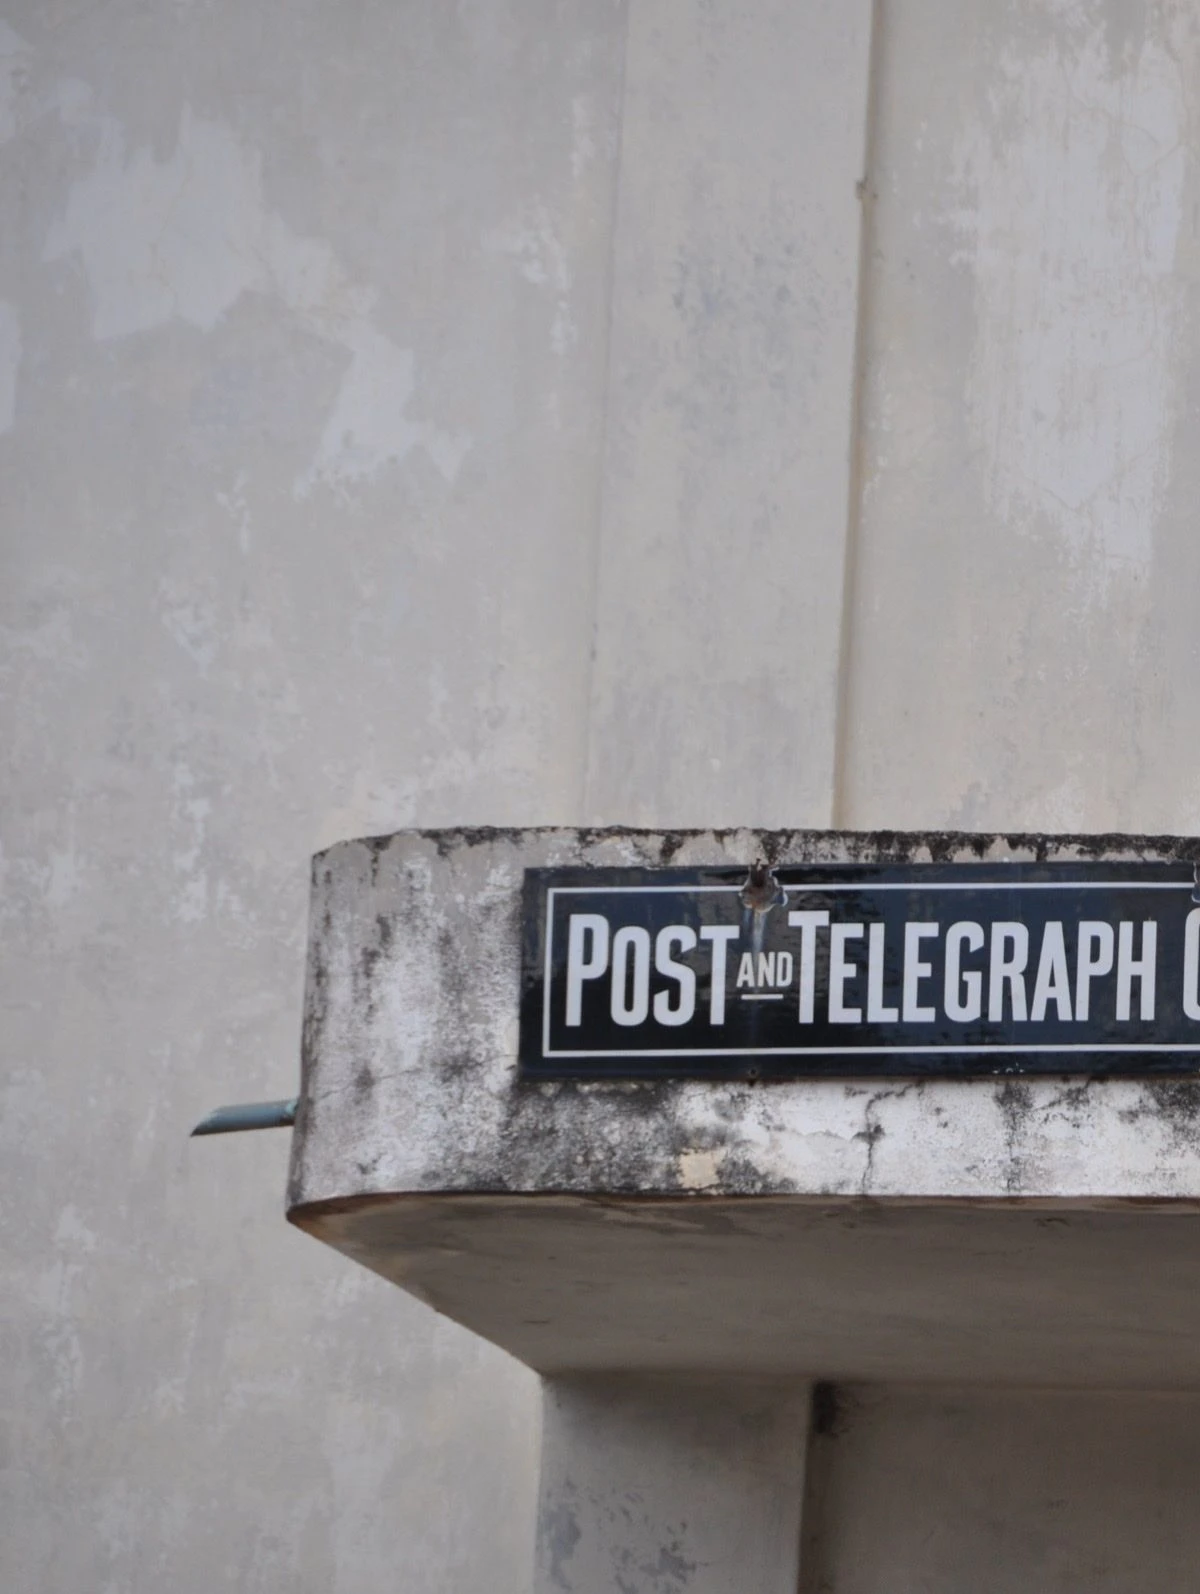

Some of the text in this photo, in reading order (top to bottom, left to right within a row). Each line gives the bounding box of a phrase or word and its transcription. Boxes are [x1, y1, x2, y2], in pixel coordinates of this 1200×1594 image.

[565, 913, 740, 1027] POST
[736, 951, 793, 988] AND
[788, 910, 1158, 1024] TELEGRAPH
